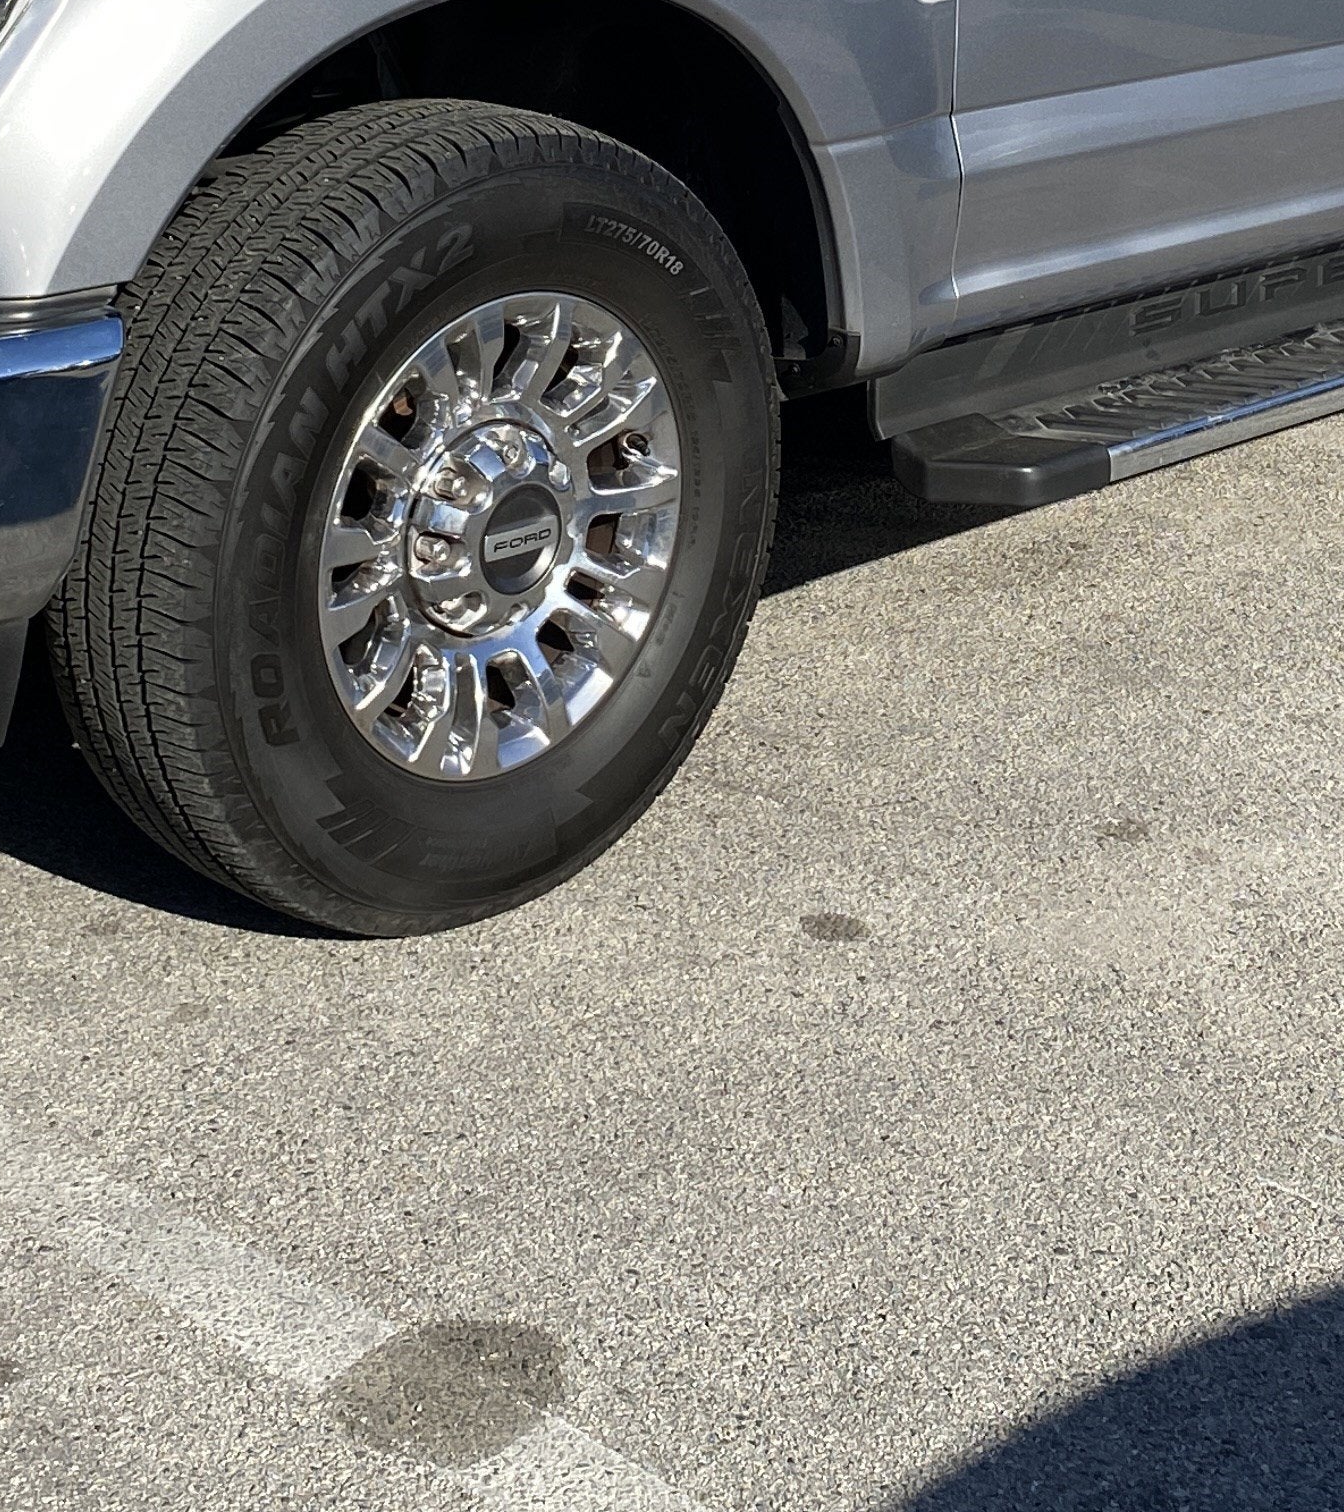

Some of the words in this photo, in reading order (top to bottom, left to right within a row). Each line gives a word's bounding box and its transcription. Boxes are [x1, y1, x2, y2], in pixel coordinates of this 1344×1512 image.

[583, 215, 684, 275] LT275/70R18
[249, 385, 332, 748] ROADIAN
[494, 528, 551, 552] FORD
